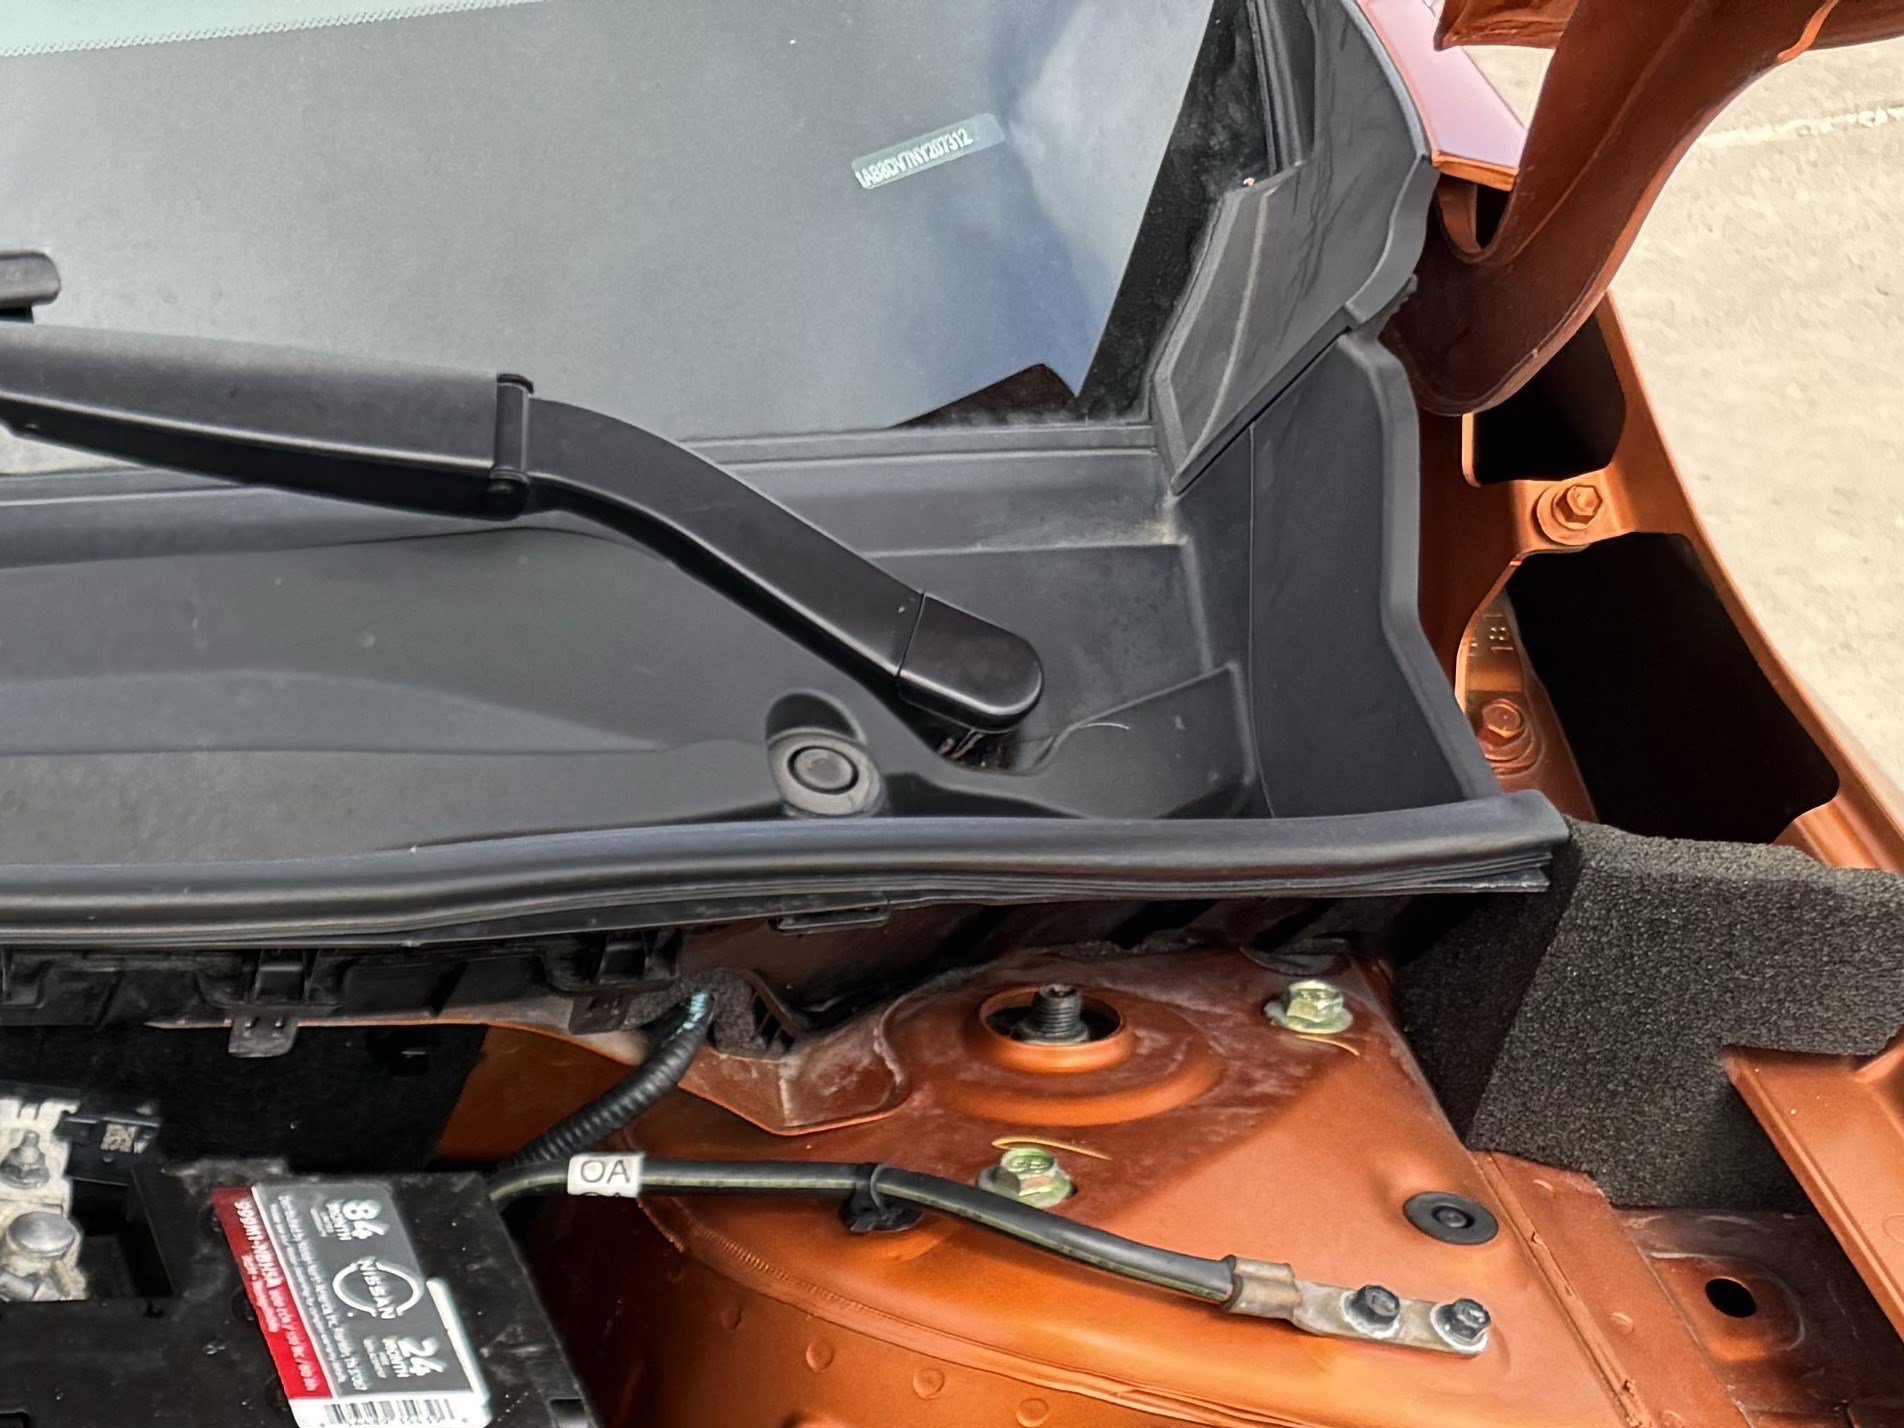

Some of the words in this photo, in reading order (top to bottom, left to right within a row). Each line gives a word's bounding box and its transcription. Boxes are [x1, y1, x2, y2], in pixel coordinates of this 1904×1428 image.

[343, 1200, 389, 1239] 84
[358, 1256, 397, 1319] NISSAN
[382, 1336, 410, 1377] MONTH
[398, 1337, 447, 1377] 24
